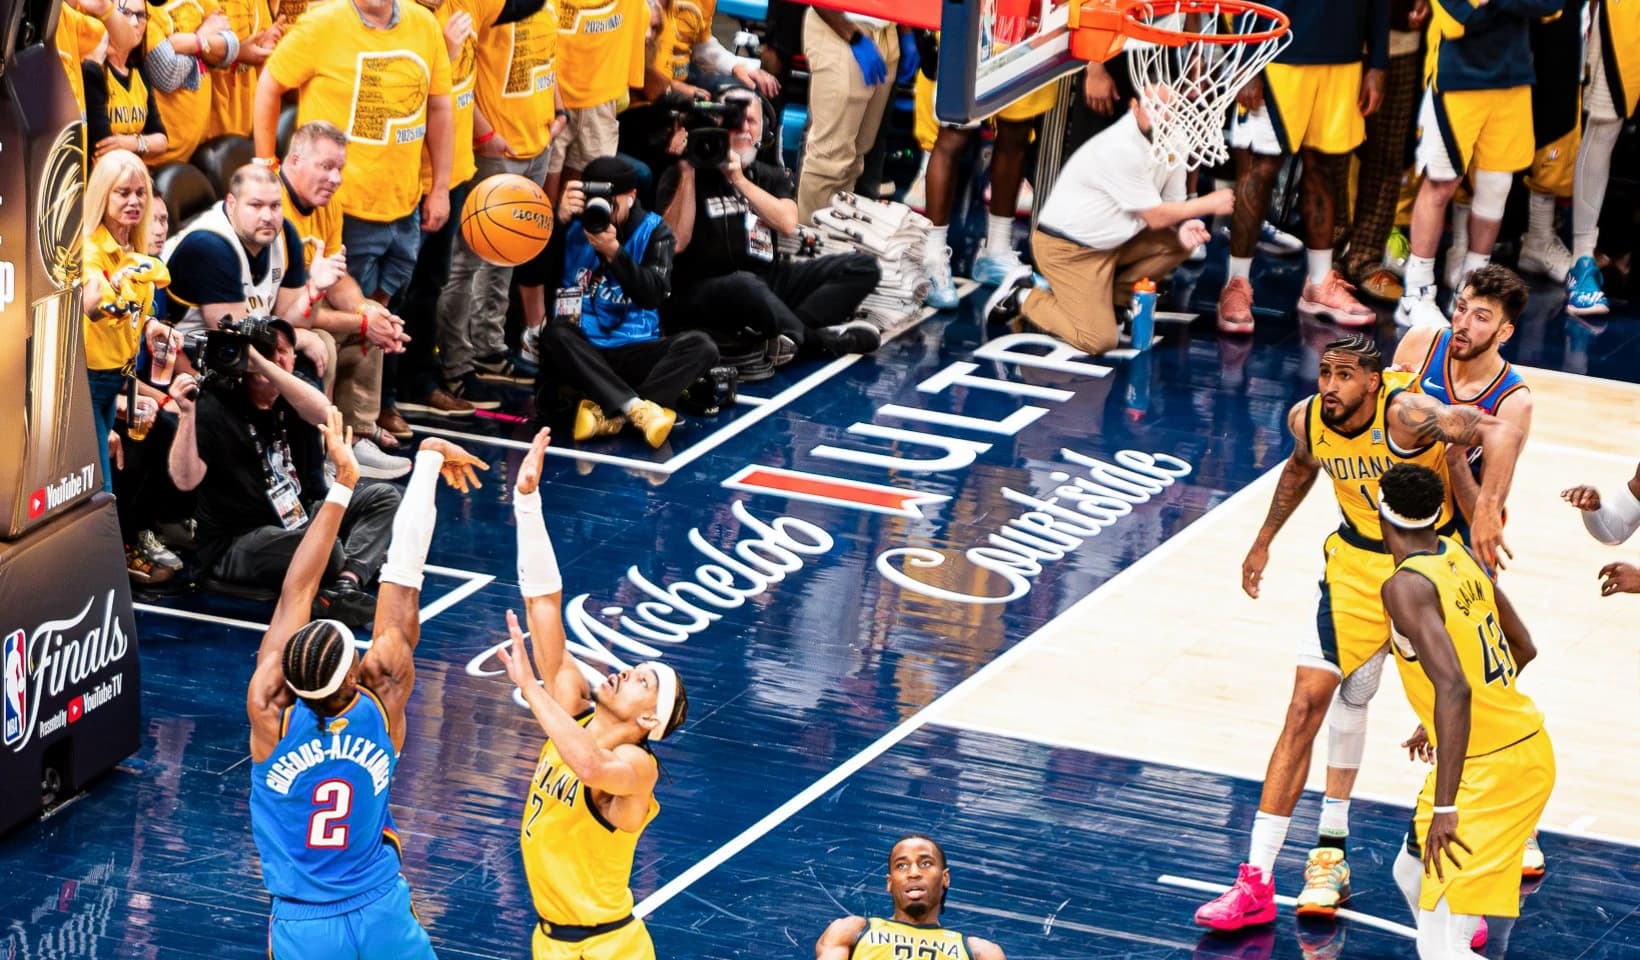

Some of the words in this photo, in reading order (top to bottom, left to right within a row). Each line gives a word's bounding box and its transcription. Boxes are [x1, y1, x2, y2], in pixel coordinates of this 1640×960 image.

[109, 105, 147, 124] INDIAN
[810, 312, 1199, 472] ULTR
[46, 472, 82, 509] YouTube
[82, 463, 94, 491] TV
[876, 447, 1192, 604] Courtside
[14, 588, 128, 752] Finals
[1477, 611, 1516, 687] 43
[82, 681, 112, 714] YouTube
[112, 672, 122, 697] TV
[7, 715, 18, 737] NBA
[39, 710, 62, 738] Presented
[306, 777, 354, 850] 2
